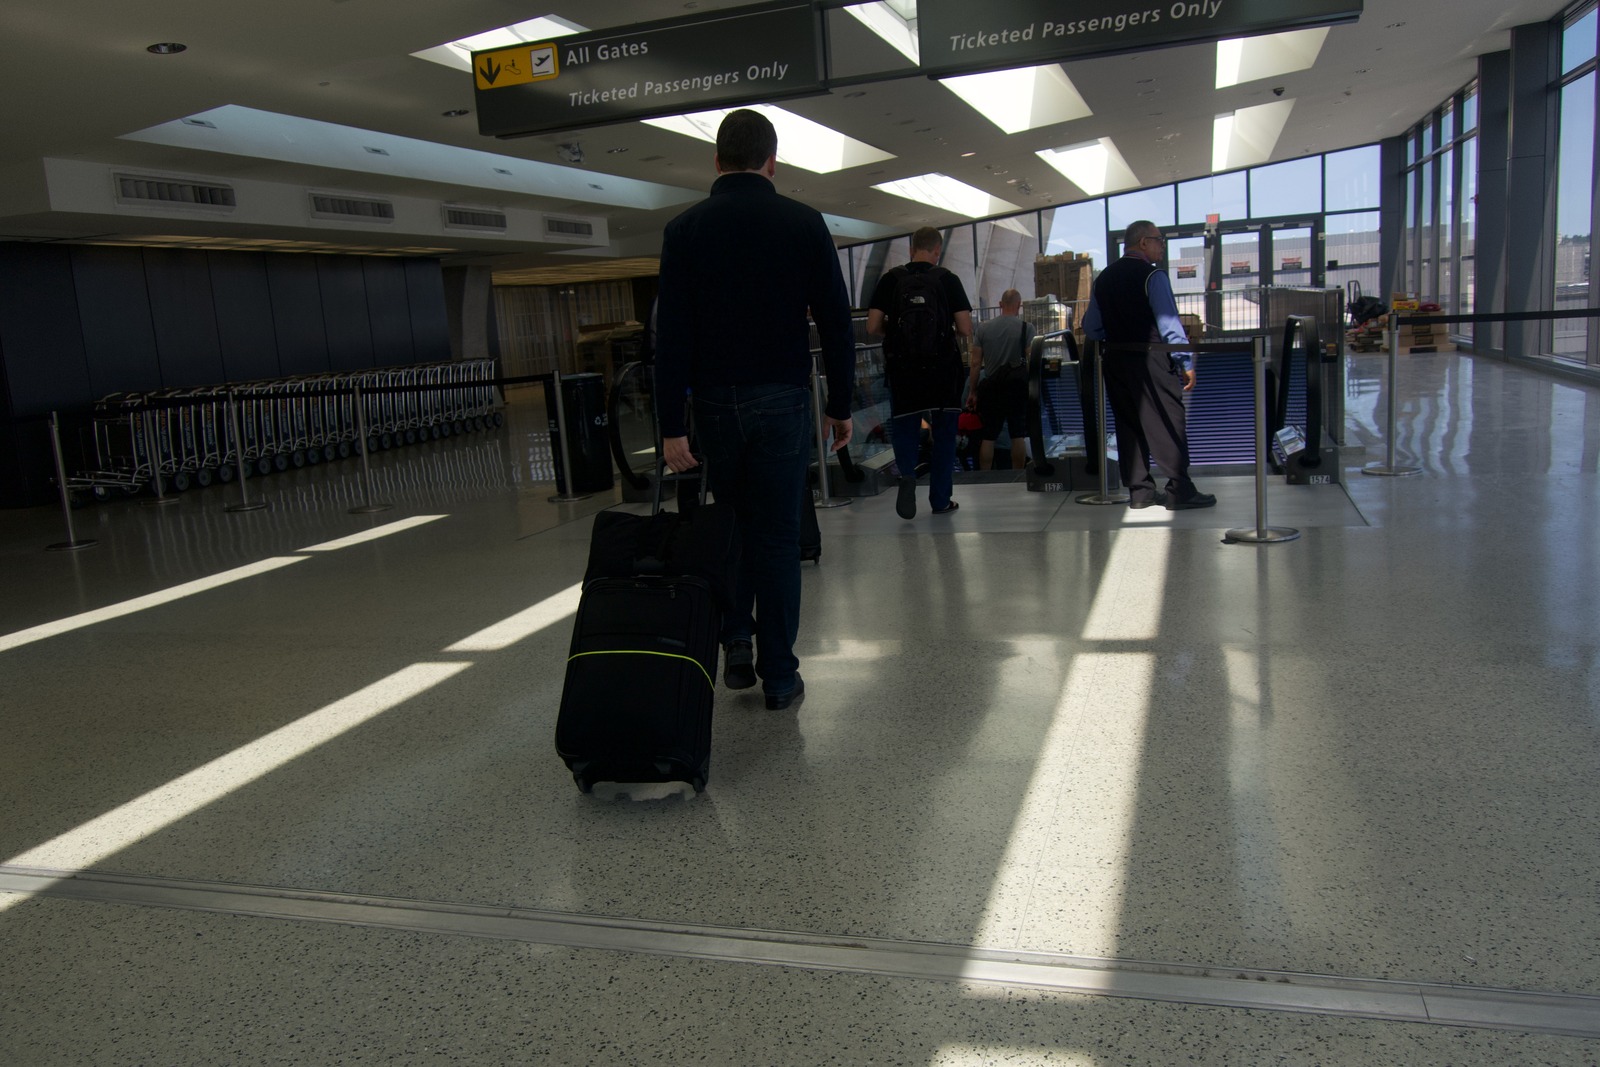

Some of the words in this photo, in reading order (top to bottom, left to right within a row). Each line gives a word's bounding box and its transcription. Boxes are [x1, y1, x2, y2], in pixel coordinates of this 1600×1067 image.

[950, 22, 1034, 52] Ticketed
[1041, 5, 1161, 39] Passengers
[1169, 0, 1223, 20] Only
[565, 45, 590, 67] All
[597, 39, 649, 62] Gates
[569, 84, 638, 107] Ticketed
[644, 68, 741, 95] Passengers
[746, 61, 789, 81] Only
